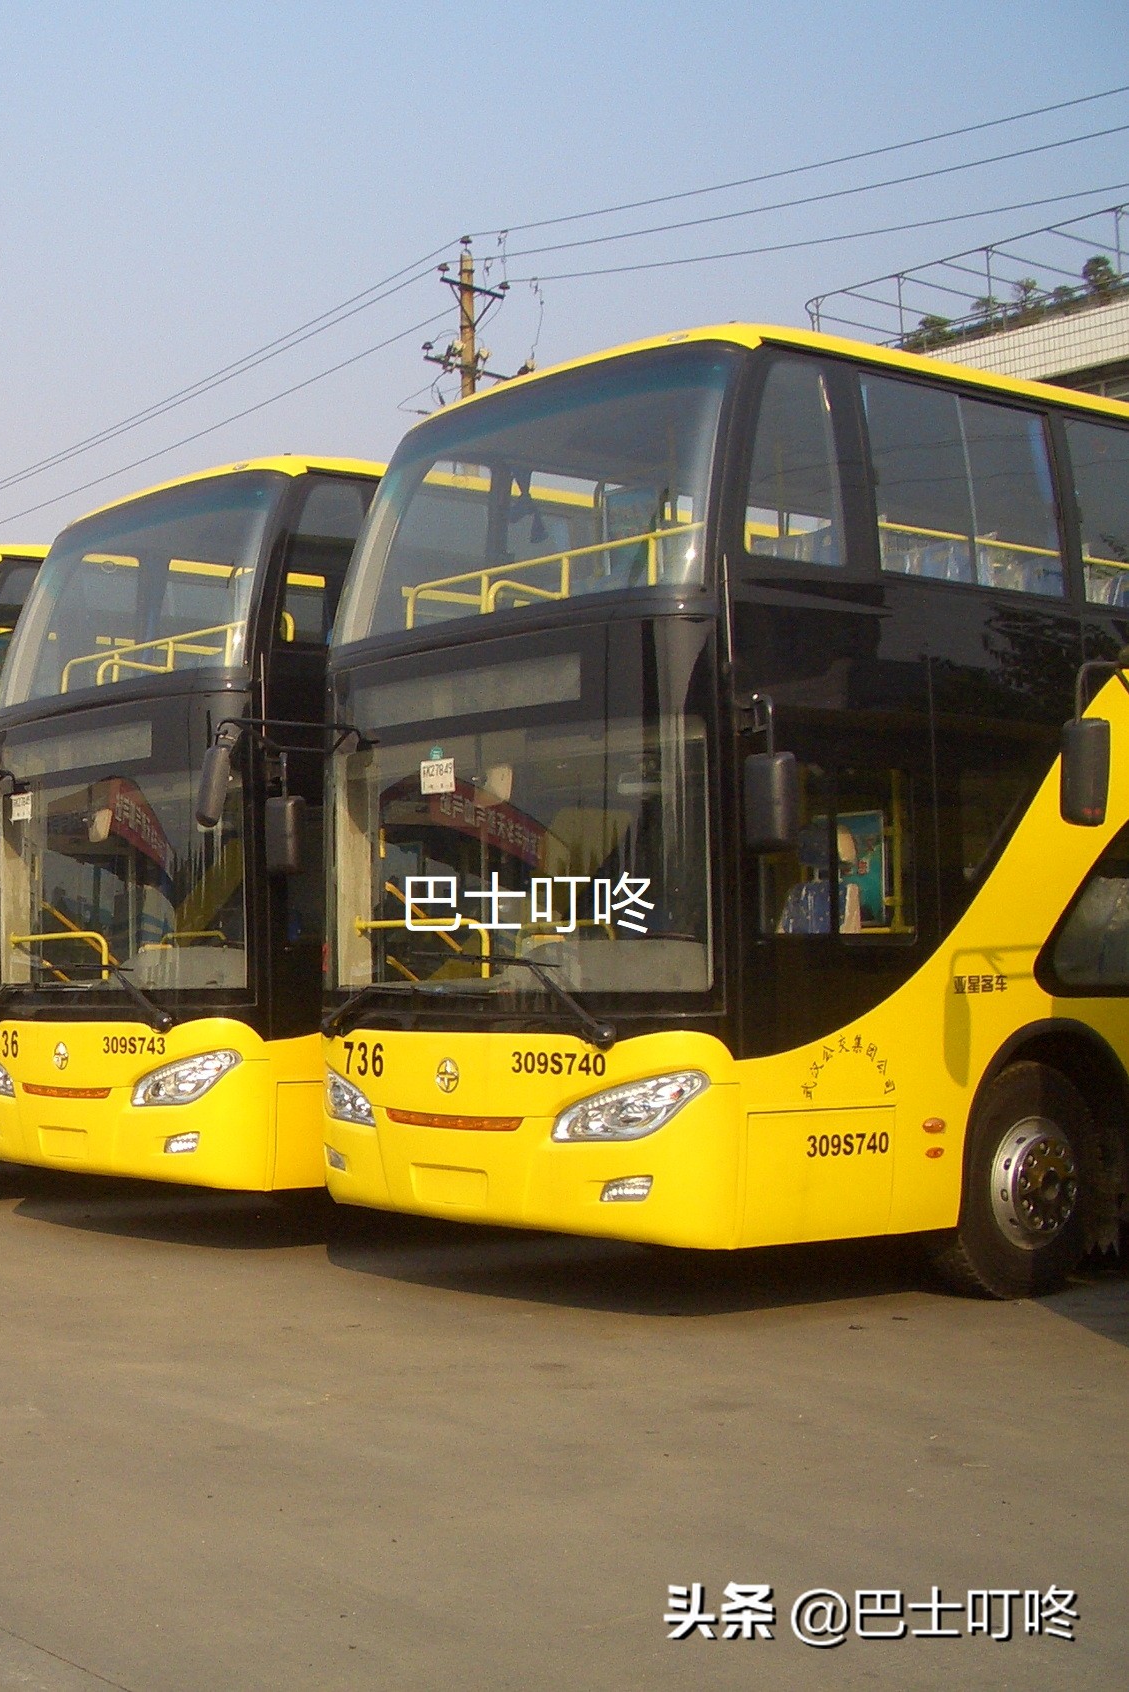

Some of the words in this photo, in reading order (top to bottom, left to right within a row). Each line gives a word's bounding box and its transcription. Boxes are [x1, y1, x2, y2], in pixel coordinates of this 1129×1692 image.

[953, 975, 1007, 994] 亚星客车
[103, 1036, 166, 1055] 309S743
[343, 1041, 384, 1077] 736
[511, 1051, 606, 1076] 309S740
[806, 1131, 889, 1158] 309S740
